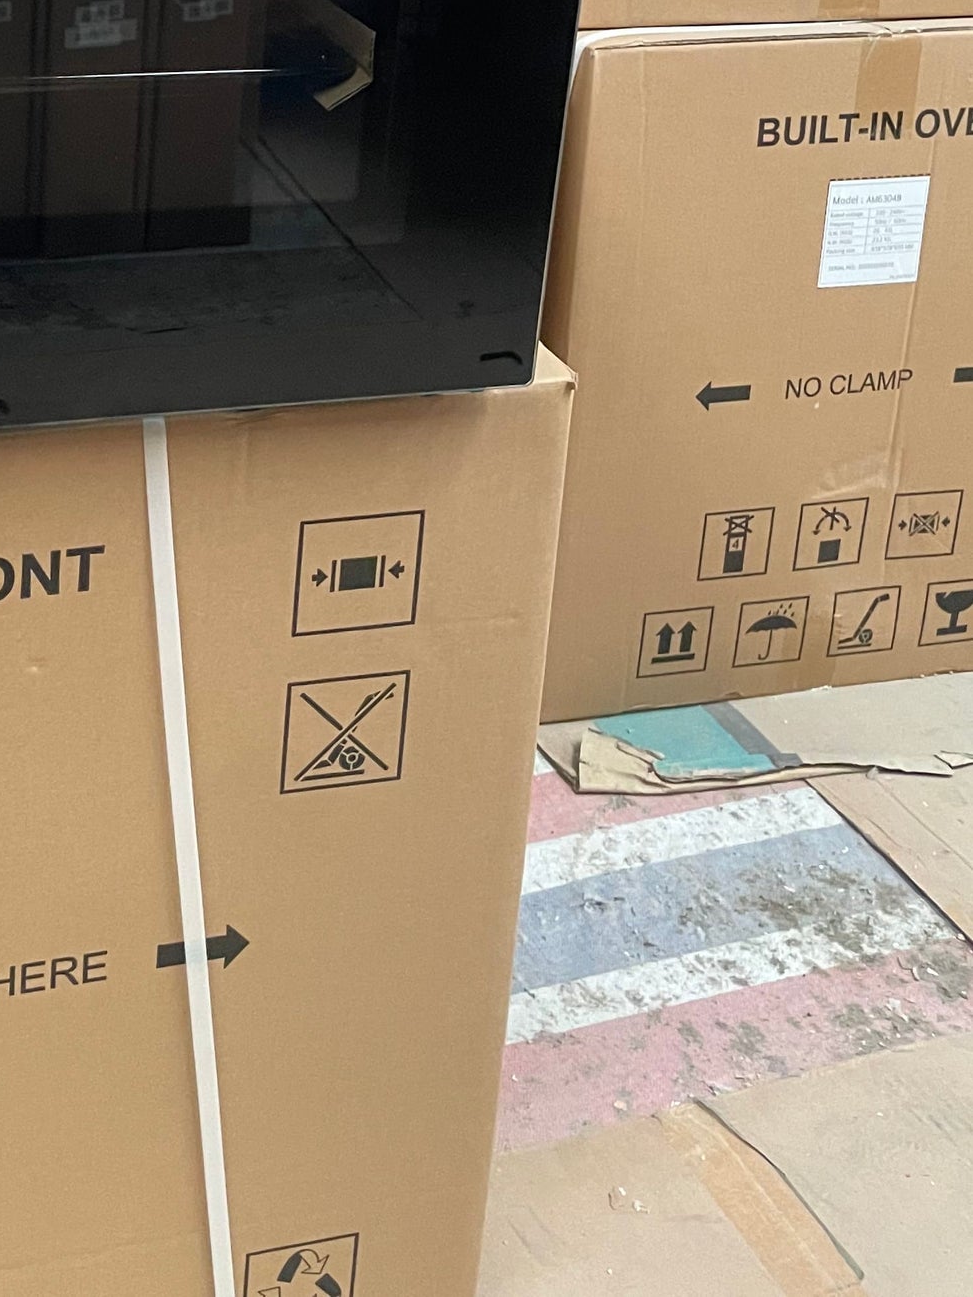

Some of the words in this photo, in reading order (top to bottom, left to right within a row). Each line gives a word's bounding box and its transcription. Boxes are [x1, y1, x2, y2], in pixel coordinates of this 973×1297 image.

[756, 110, 904, 148] BUILT-IN
[832, 195, 859, 205] Model
[785, 376, 822, 400] NO
[829, 368, 913, 396] CLAMP
[731, 537, 741, 551] 4
